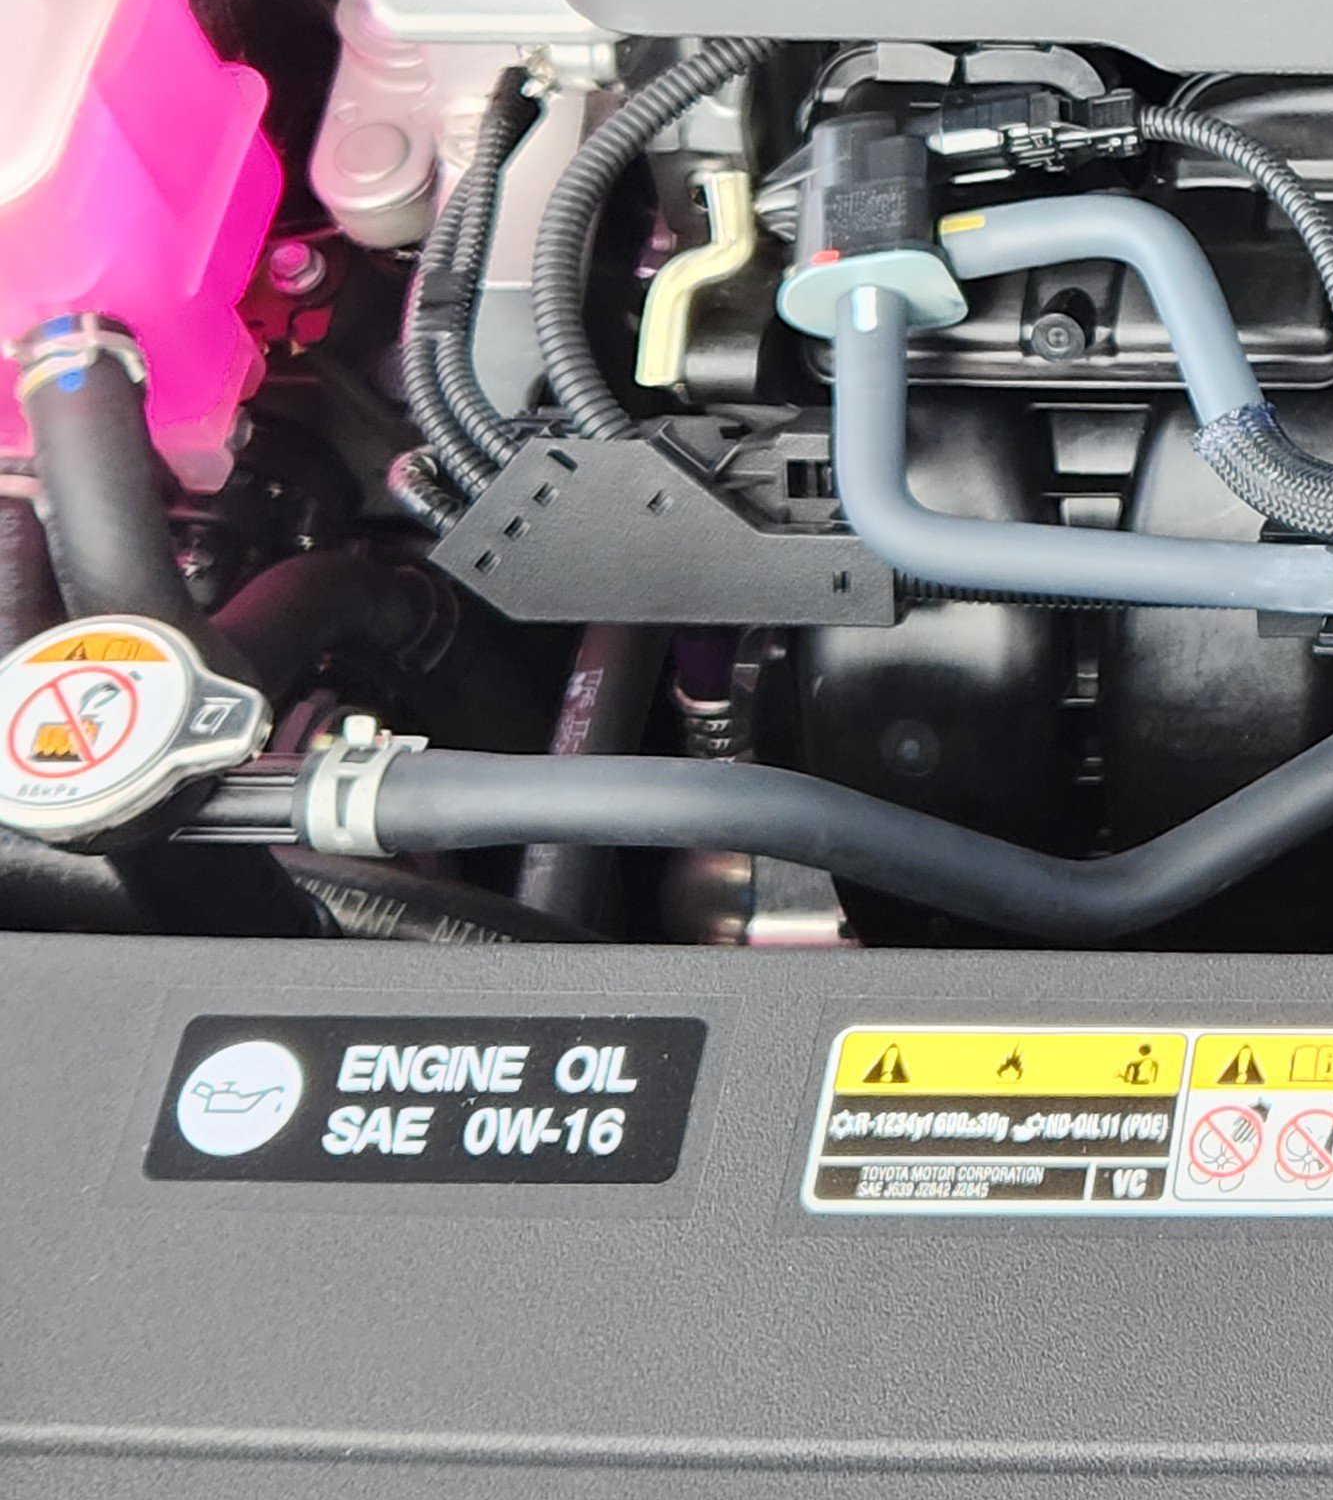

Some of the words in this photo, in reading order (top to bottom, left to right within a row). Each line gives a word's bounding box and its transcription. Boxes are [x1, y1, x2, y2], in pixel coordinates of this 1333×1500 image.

[337, 1044, 531, 1094] ENGINE
[554, 1044, 638, 1094] OIL
[321, 1106, 436, 1156] SAE
[463, 1106, 626, 1157] 0W-16
[856, 1182, 884, 1198] SAE
[861, 1166, 909, 1182] TOYOTA
[910, 1166, 956, 1182] MOTOR
[957, 1166, 1046, 1185] CORPORATION
[1112, 1168, 1149, 1198] VC
